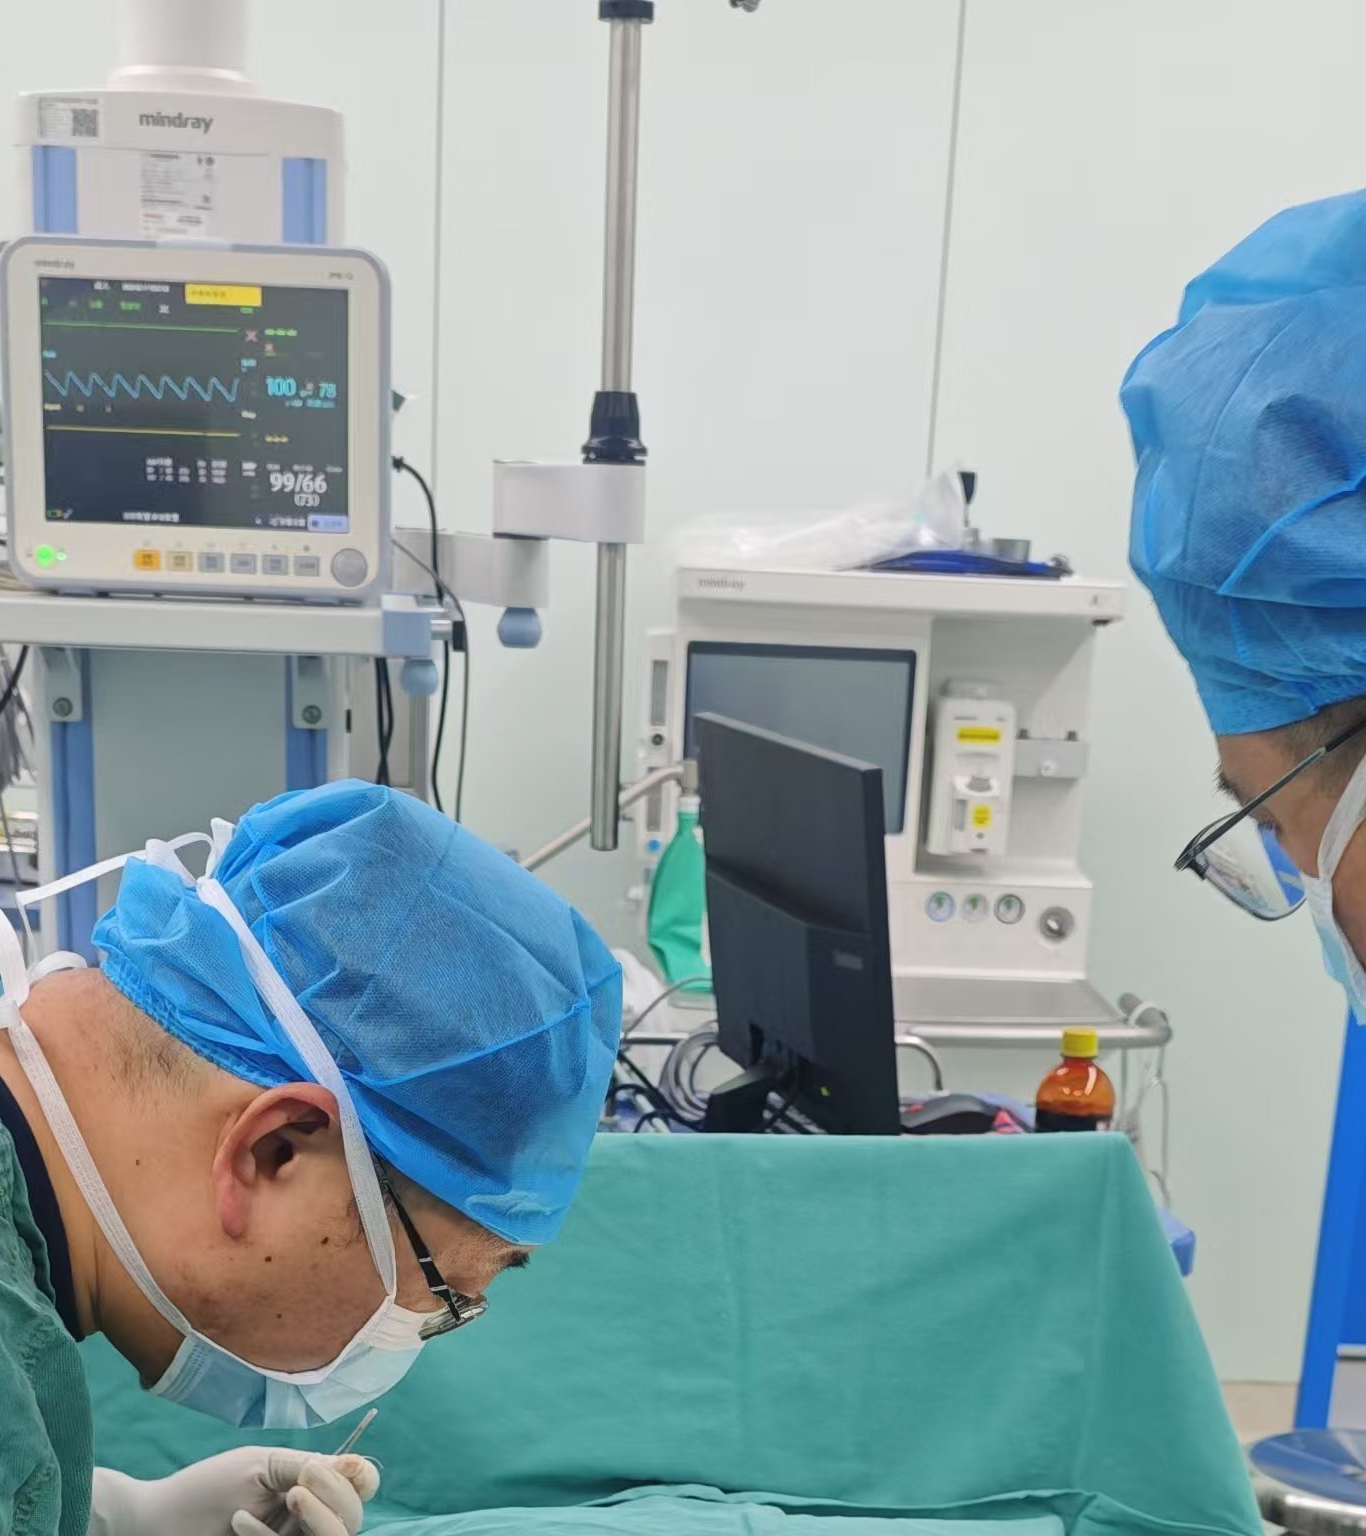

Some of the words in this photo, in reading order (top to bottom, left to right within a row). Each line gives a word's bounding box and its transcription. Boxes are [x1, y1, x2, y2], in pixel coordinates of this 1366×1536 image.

[139, 112, 214, 134] mindray
[266, 377, 296, 396] 100
[269, 472, 327, 493] 99/66
